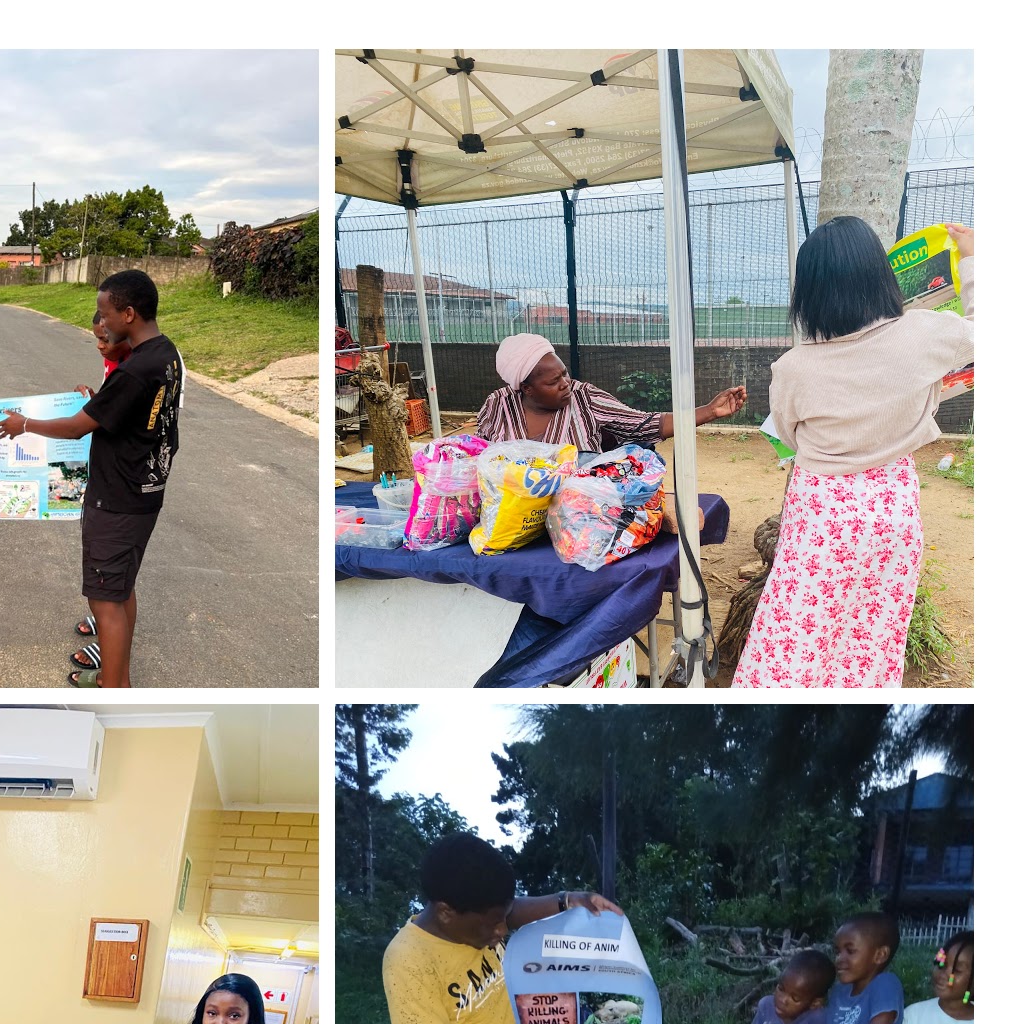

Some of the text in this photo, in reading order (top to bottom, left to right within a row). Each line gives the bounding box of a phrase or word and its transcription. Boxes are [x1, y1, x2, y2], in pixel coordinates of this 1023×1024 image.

[544, 939, 620, 952] KILLING OF ANIM
[533, 995, 558, 1005] STOP
